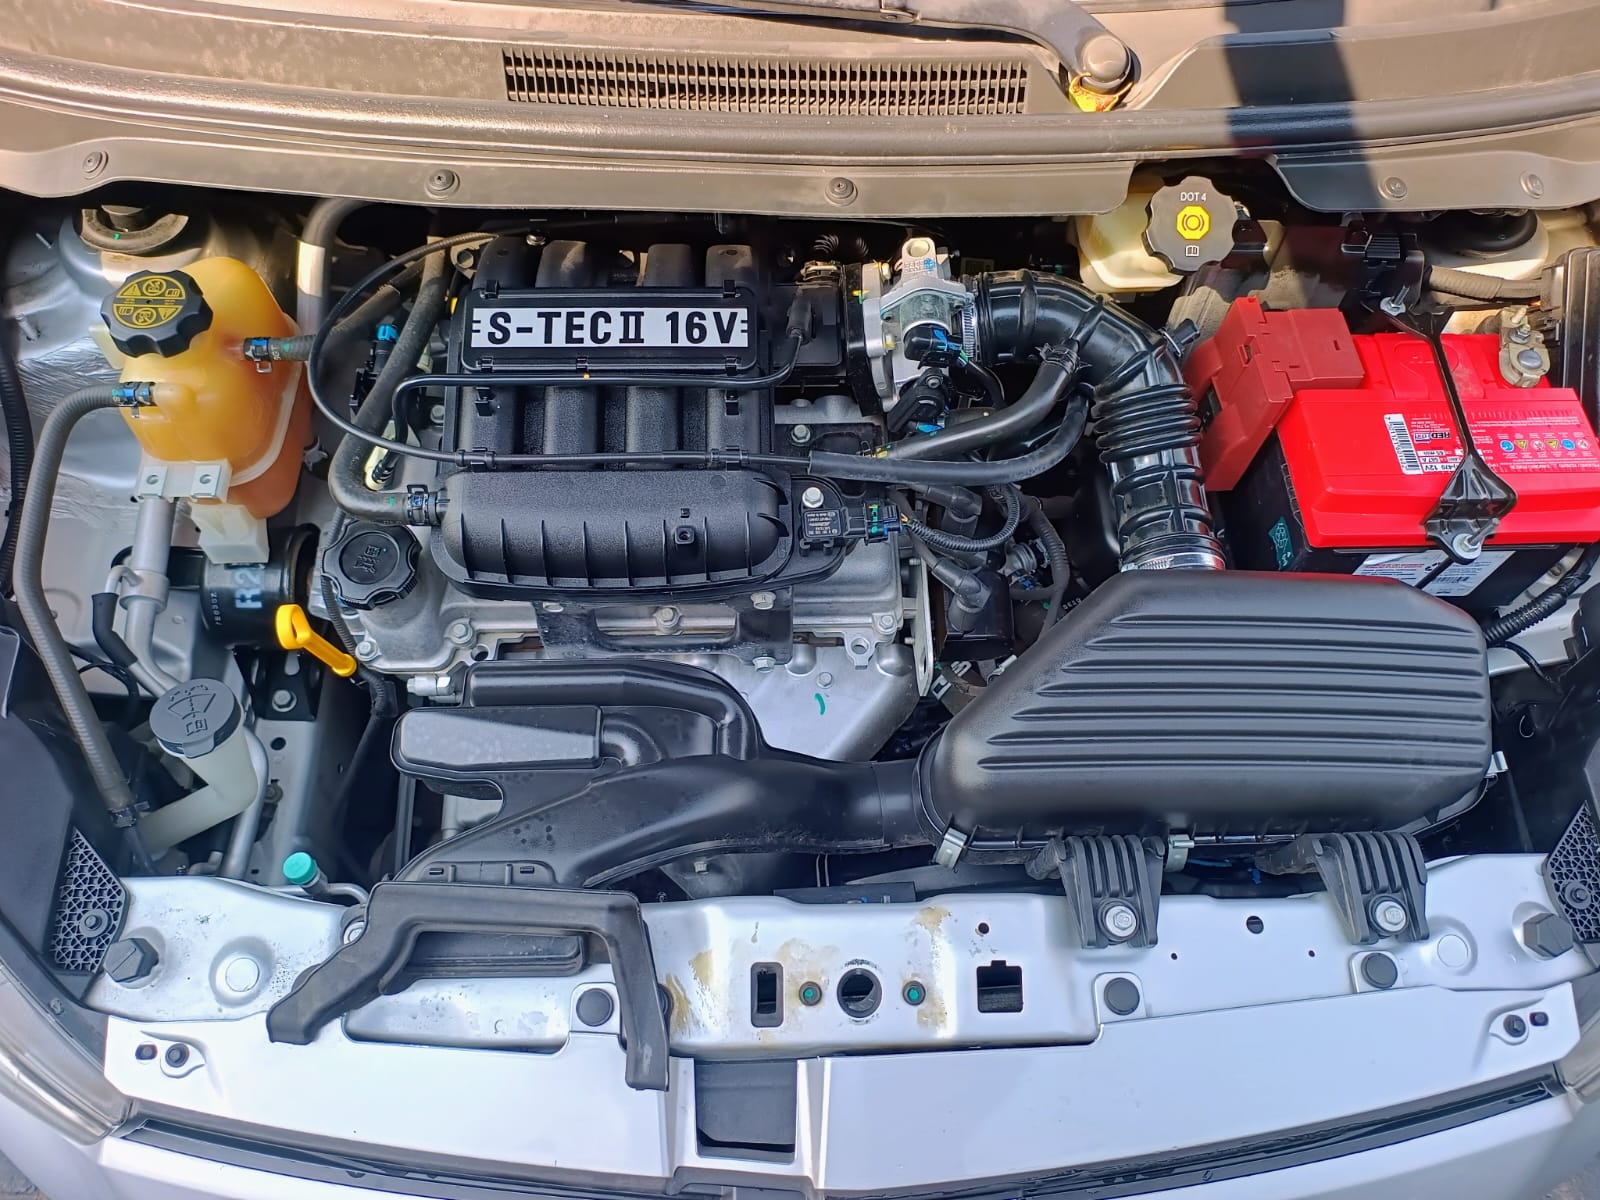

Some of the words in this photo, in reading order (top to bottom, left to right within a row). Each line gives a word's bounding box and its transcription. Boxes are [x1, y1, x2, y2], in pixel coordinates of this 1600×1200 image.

[1180, 192, 1200, 201] DOT
[1201, 192, 1207, 201] 4
[665, 311, 738, 344] 16V
